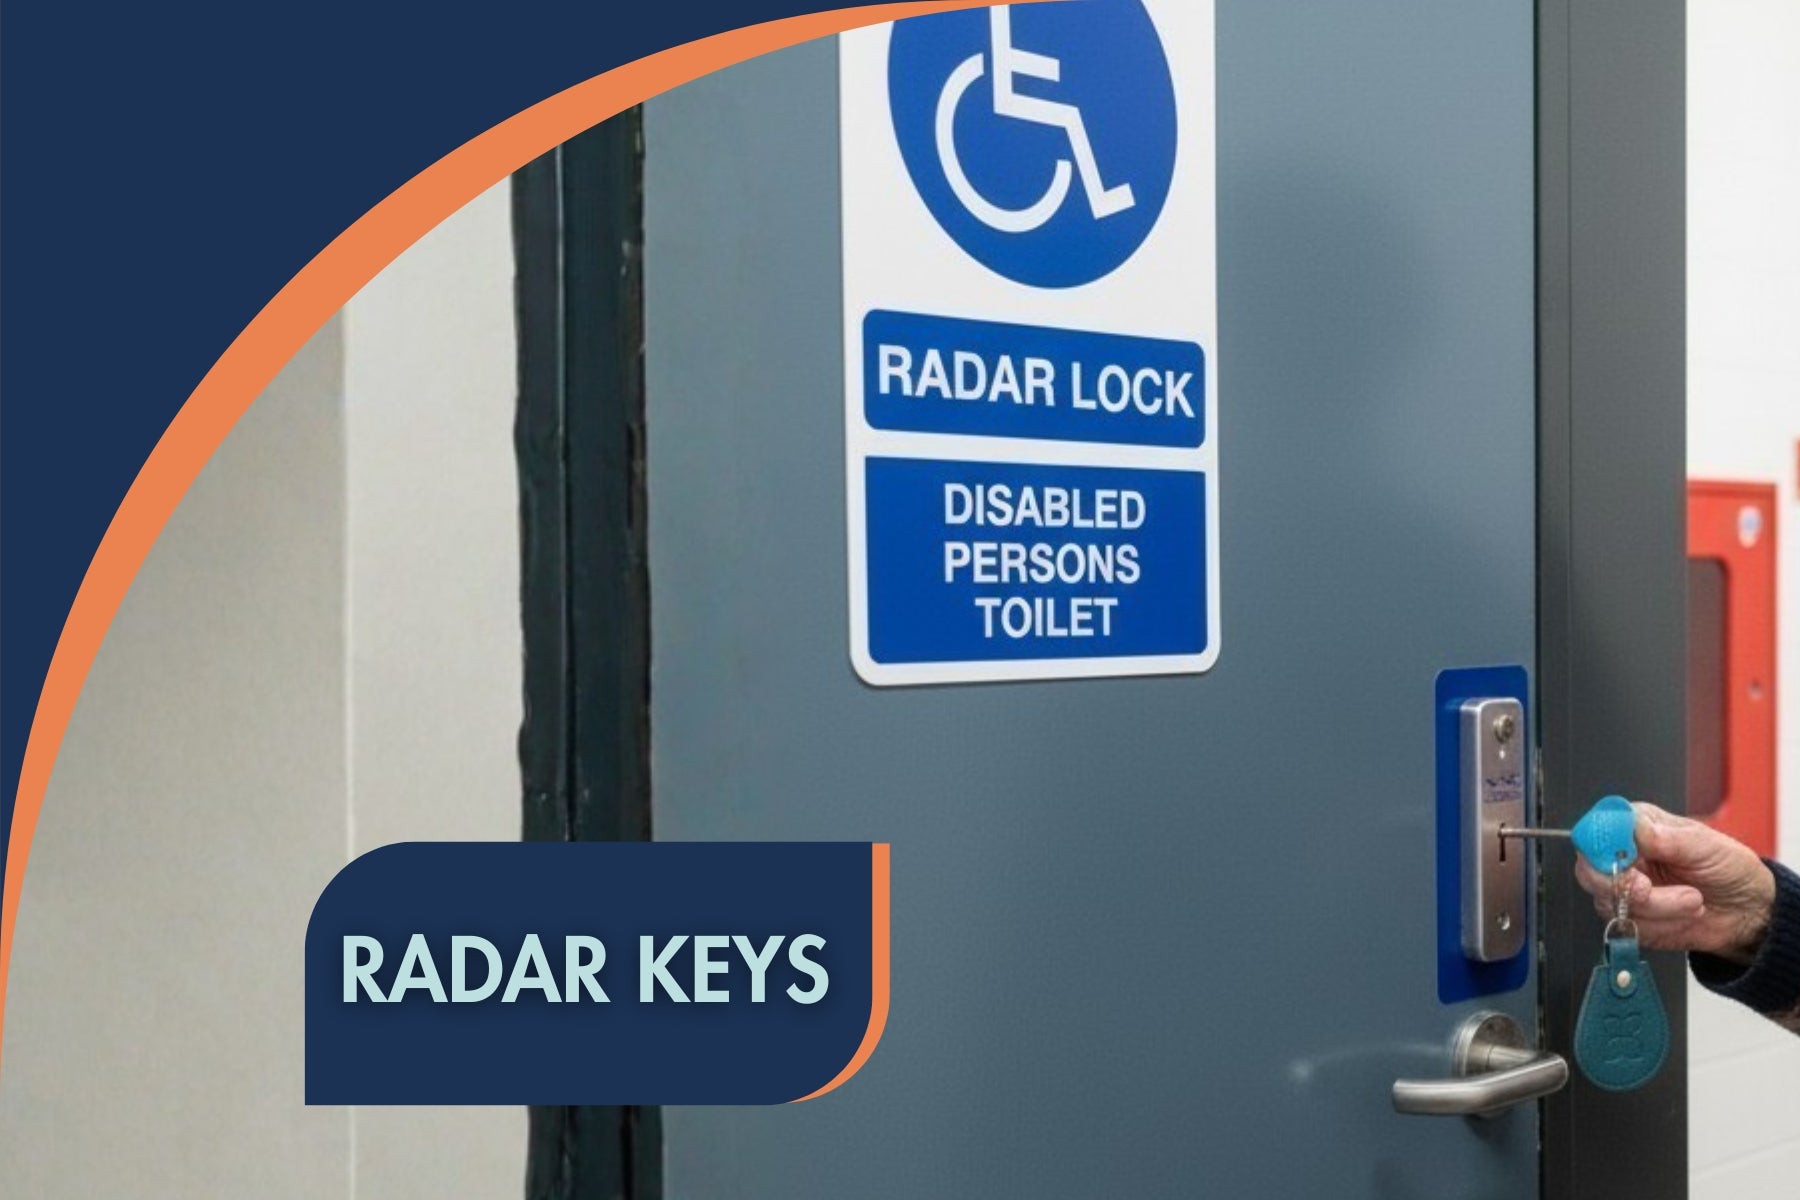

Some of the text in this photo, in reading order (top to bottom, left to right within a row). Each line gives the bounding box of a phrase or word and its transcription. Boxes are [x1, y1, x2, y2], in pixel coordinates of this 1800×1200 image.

[878, 344, 1196, 419] RADAR LOCK
[944, 483, 1147, 530] DISABLED
[944, 541, 1142, 585] PERSONS
[974, 596, 1119, 639] TOILET
